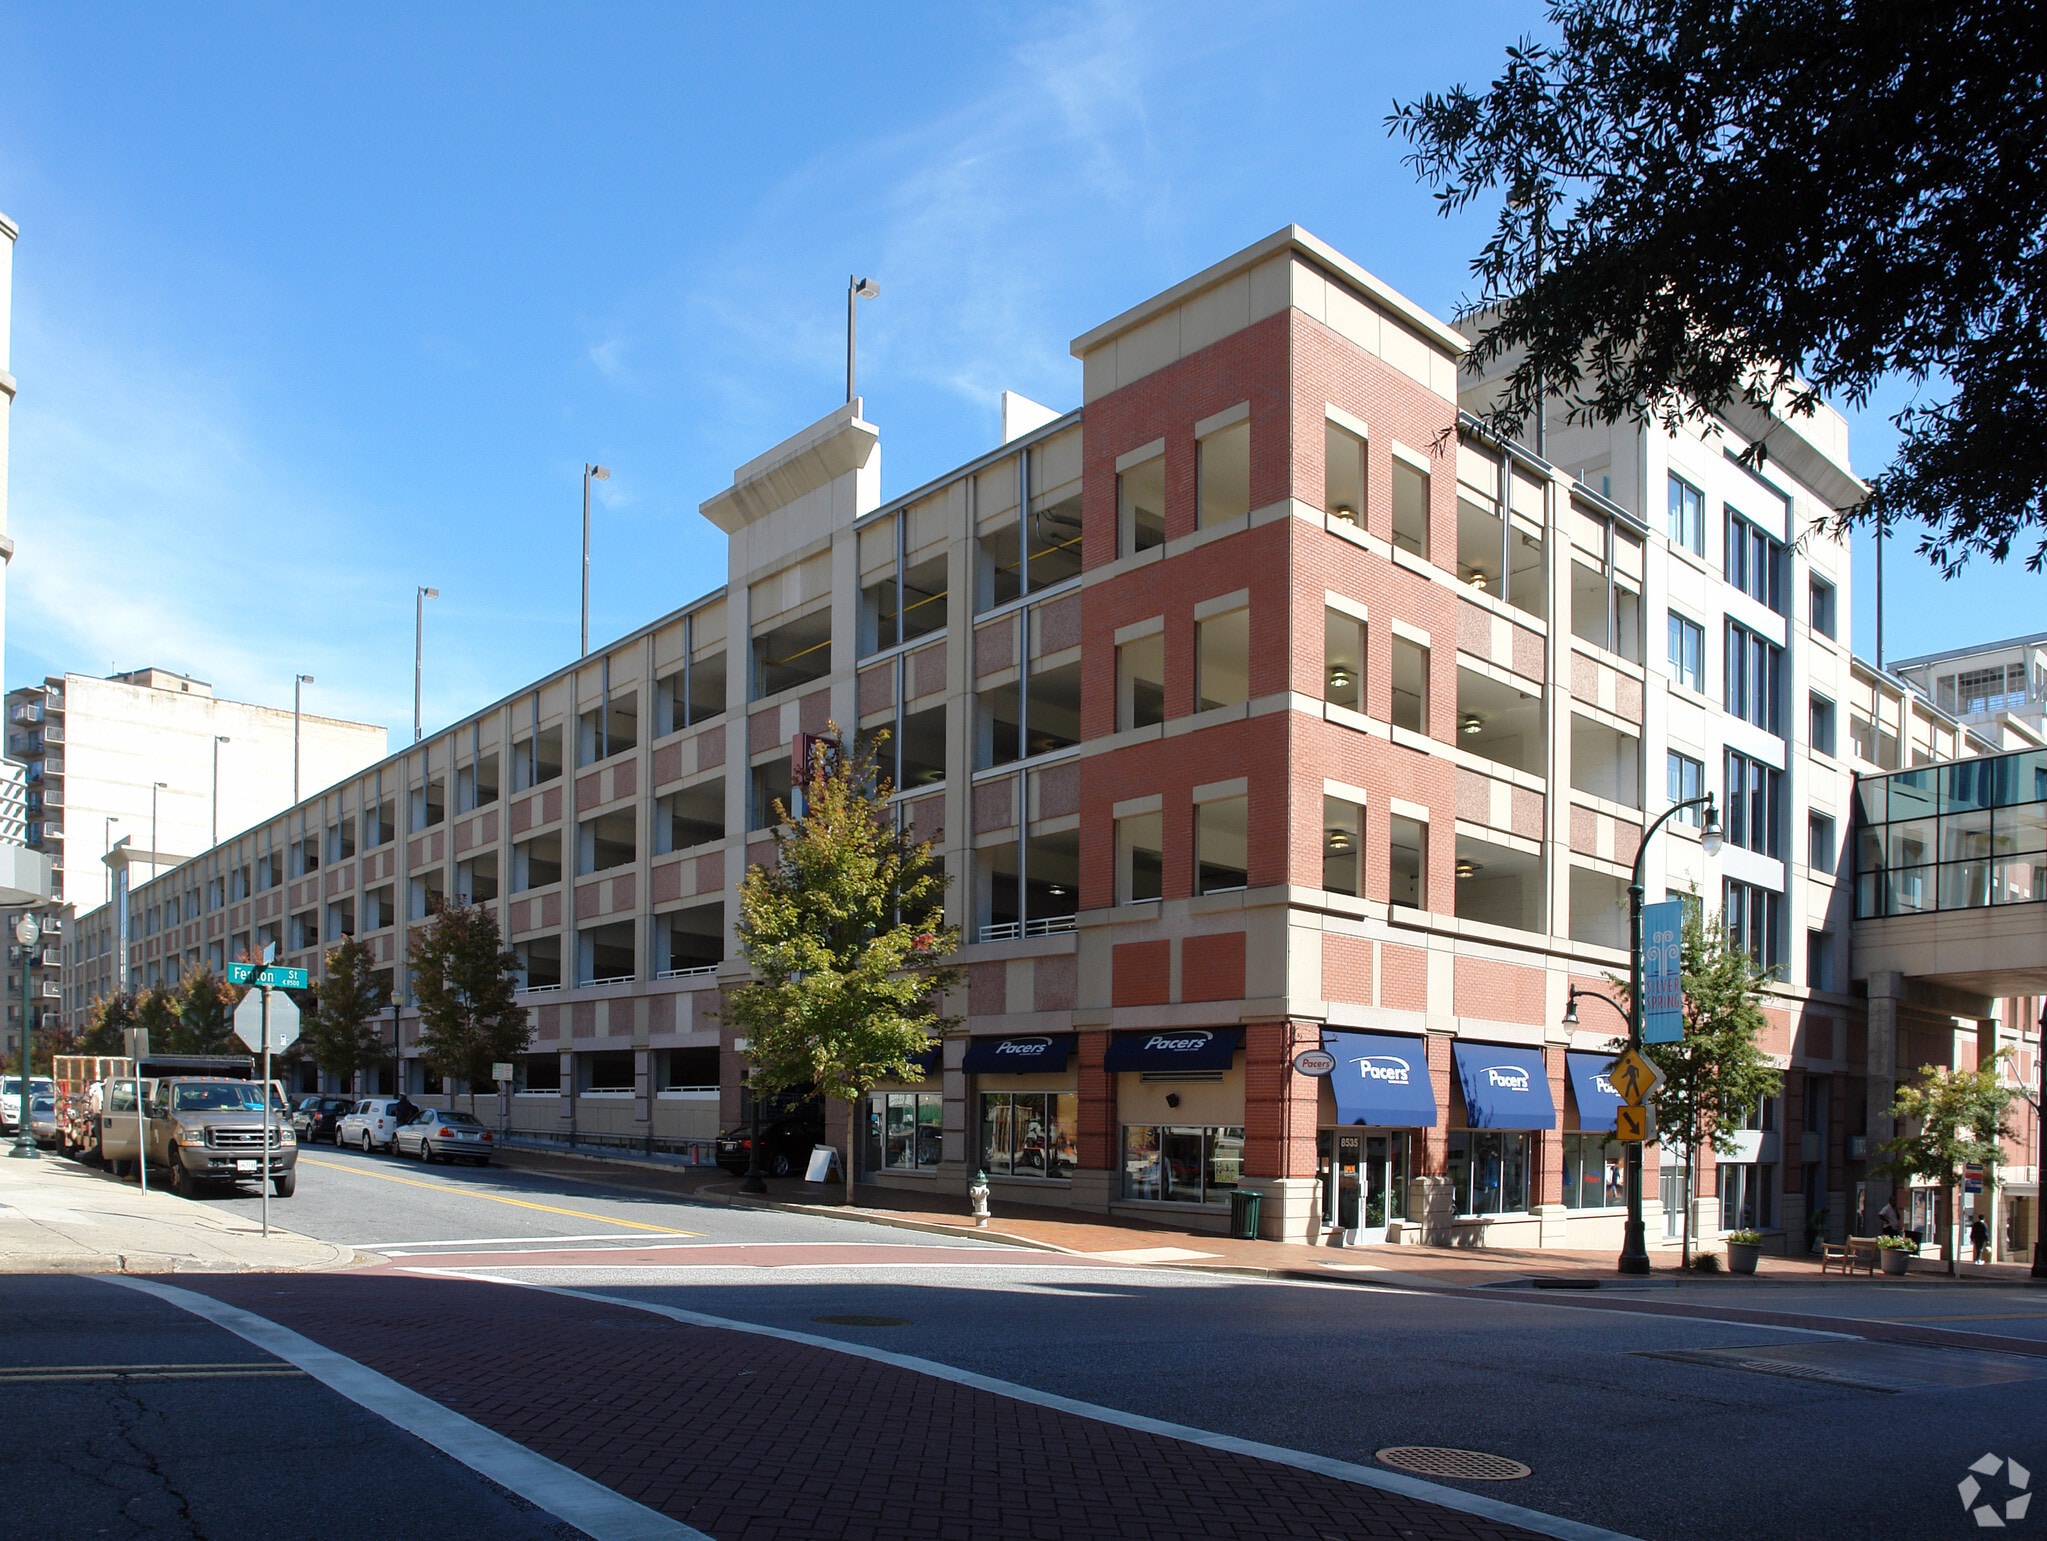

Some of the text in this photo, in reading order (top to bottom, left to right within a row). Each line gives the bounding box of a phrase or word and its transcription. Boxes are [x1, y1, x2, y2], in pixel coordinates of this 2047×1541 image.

[234, 967, 298, 982] Fenton St
[1647, 978, 1679, 994] SILVER
[1647, 994, 1680, 1010] SPRING
[995, 1041, 1047, 1054] Pacers
[1143, 1036, 1207, 1050] Pacers
[1302, 1058, 1330, 1069] Pacers
[1360, 1060, 1408, 1081] Pacers
[1489, 1069, 1528, 1088] Pacers
[1596, 1077, 1619, 1094] Pac
[1340, 1137, 1358, 1148] 8535
